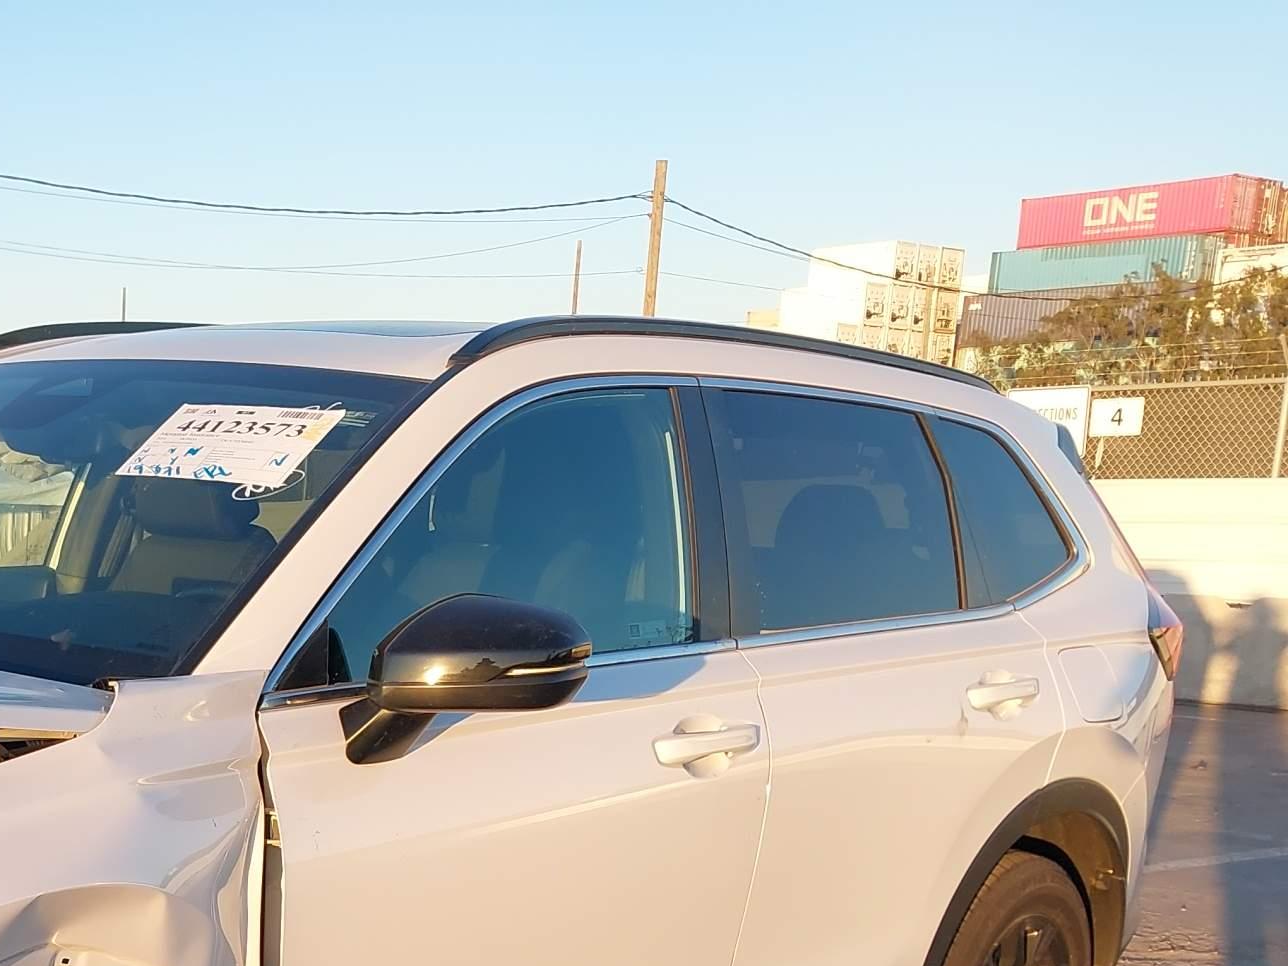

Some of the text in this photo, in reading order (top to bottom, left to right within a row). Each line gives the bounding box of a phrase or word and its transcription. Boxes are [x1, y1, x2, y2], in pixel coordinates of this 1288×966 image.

[1083, 191, 1160, 227] ONE
[1110, 407, 1124, 427] 4
[176, 419, 308, 438] 44123573
